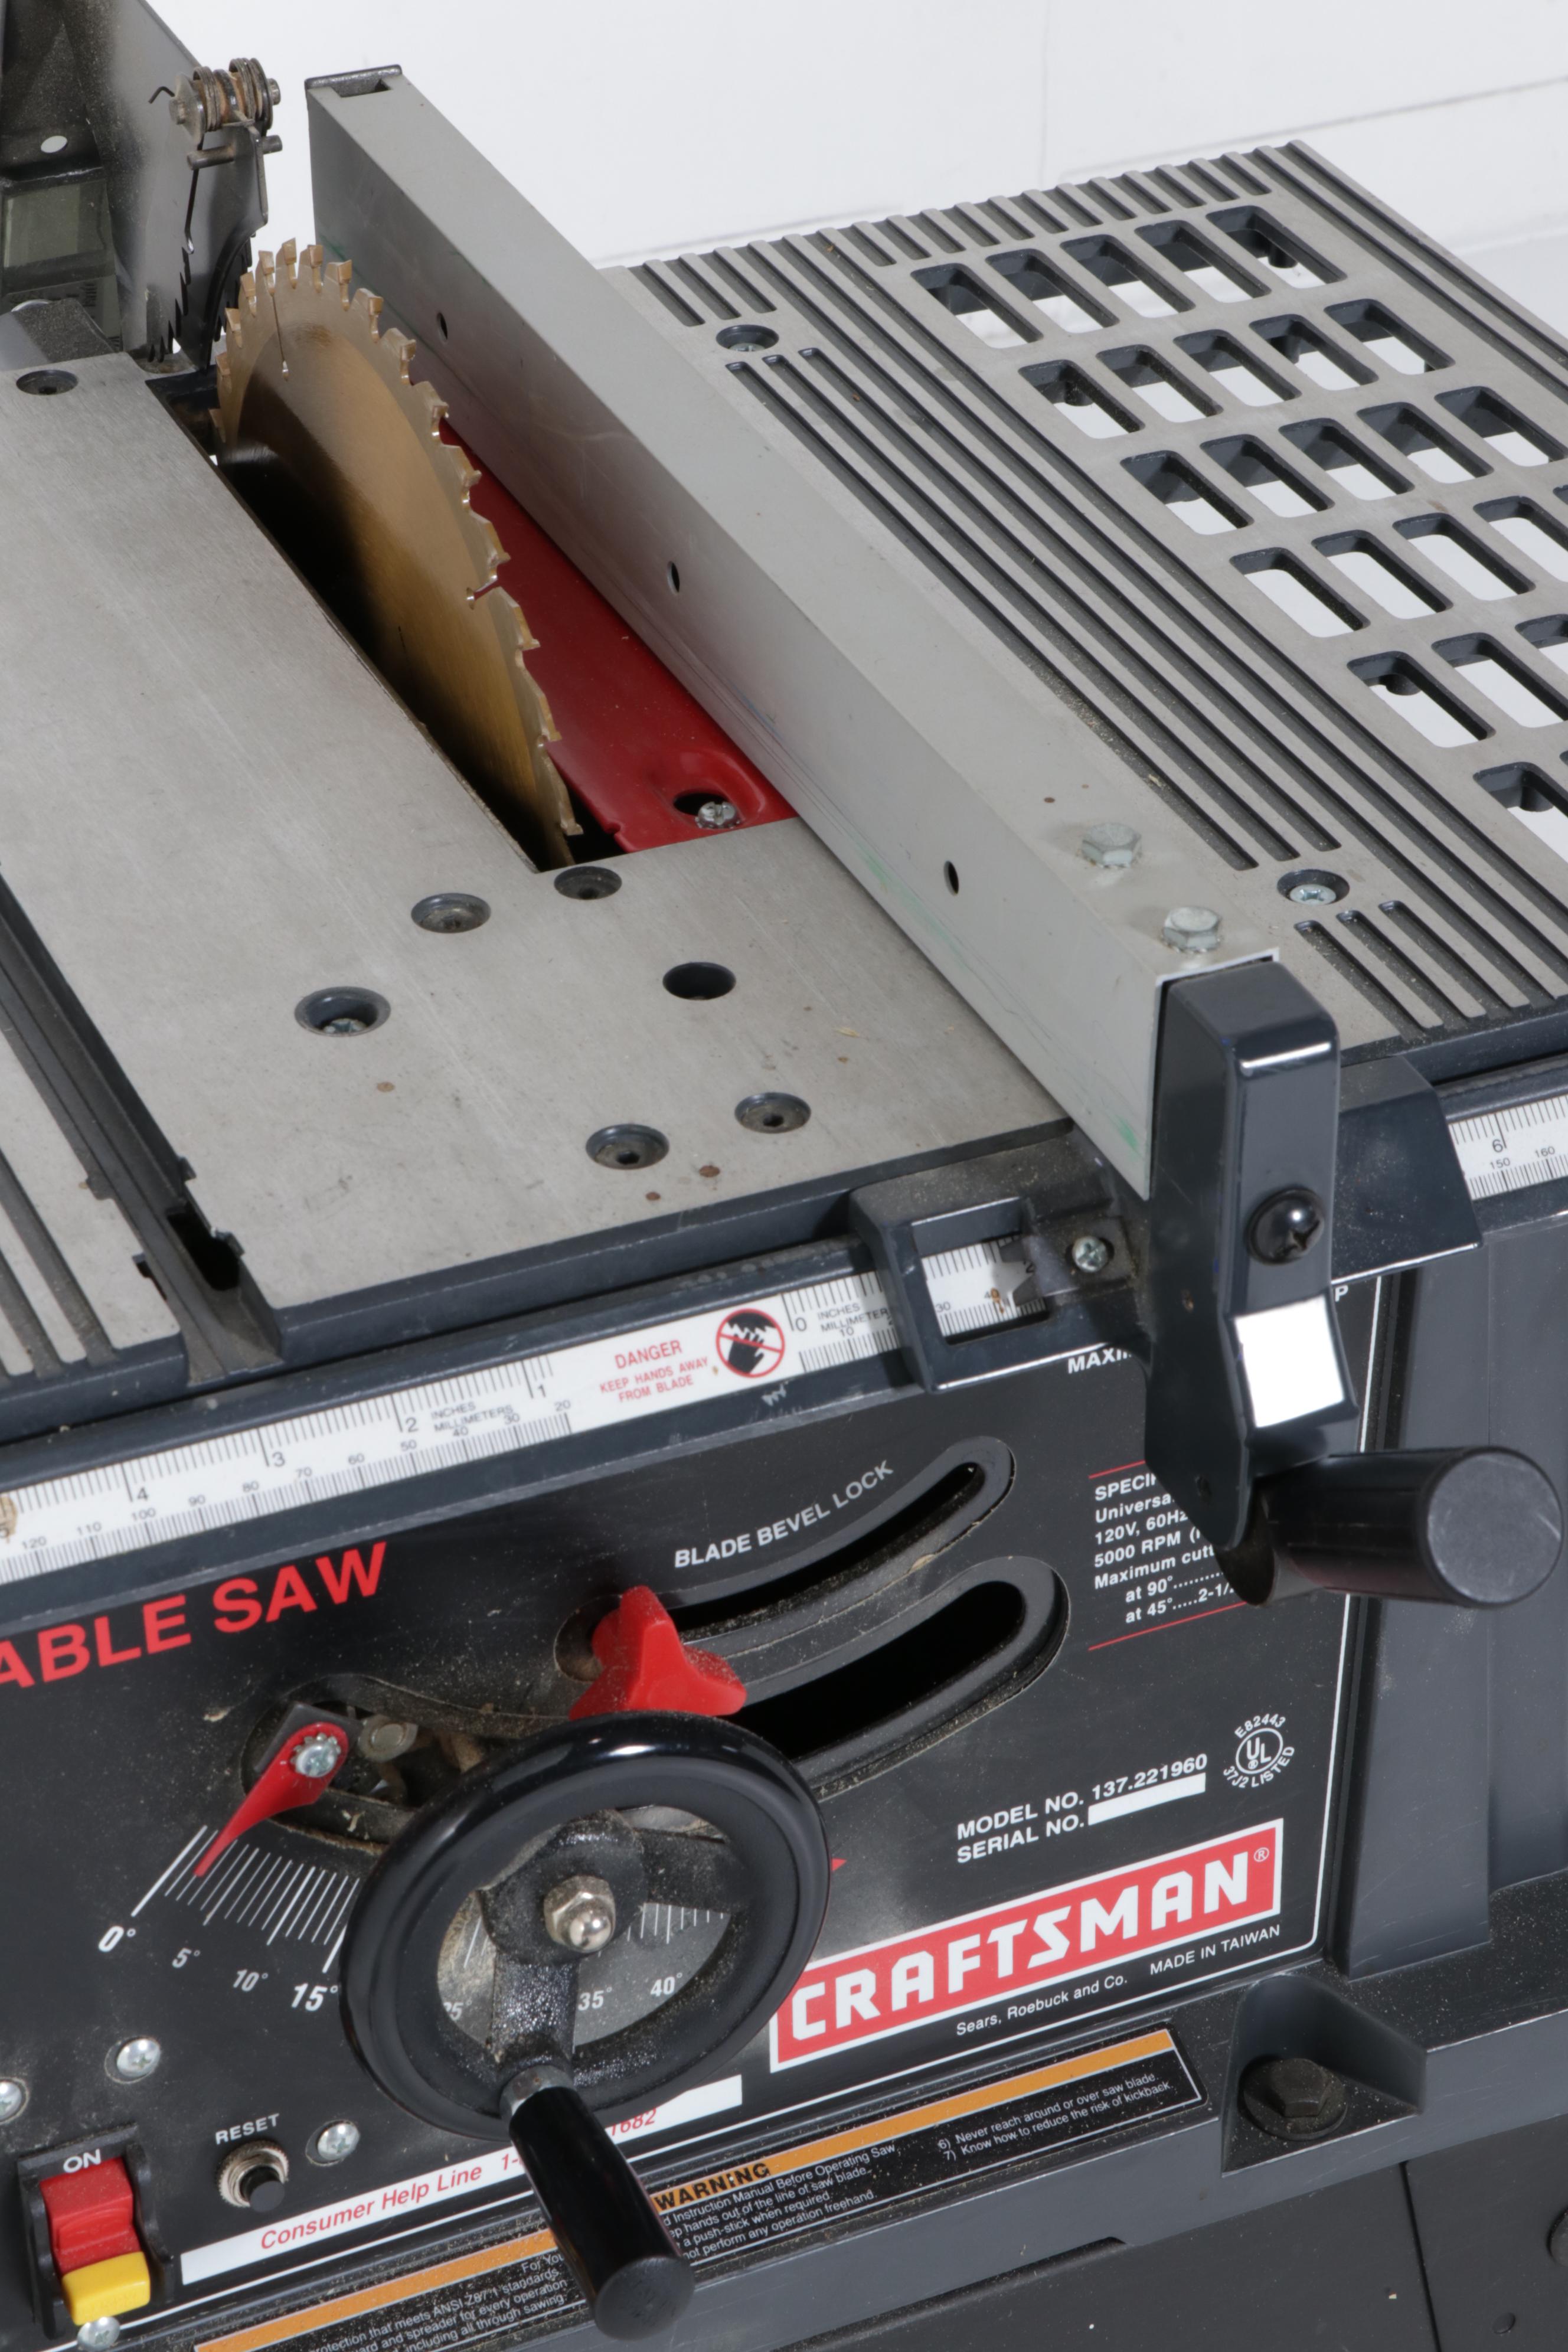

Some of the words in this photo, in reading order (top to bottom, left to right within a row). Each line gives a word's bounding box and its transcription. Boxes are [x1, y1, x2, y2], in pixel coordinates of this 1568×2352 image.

[1492, 1139, 1504, 1153] 6
[1536, 1146, 1556, 1158] 160
[1490, 1157, 1511, 1170] 150
[818, 1302, 861, 1320] INCHES
[820, 1307, 890, 1332] MILLIMETER
[936, 1302, 951, 1314] 30
[795, 1317, 808, 1332] 0
[839, 1327, 854, 1337] 10
[614, 1340, 682, 1369] DANGER
[1067, 1347, 1132, 1374] MAXI
[599, 1377, 629, 1394] KEEP
[634, 1366, 674, 1385] HANDS
[680, 1357, 710, 1373] AWAY
[538, 1383, 546, 1398] 1
[618, 1387, 652, 1403] FROM
[656, 1375, 694, 1394] BLADE
[430, 1401, 476, 1420] INCHES
[434, 1404, 515, 1433] MILLIMETERS
[554, 1399, 572, 1412] 20
[405, 1417, 419, 1433] 2
[452, 1426, 469, 1437] 40
[504, 1413, 521, 1425] 30
[400, 1439, 418, 1452] 50
[272, 1451, 286, 1468] 3
[295, 1466, 313, 1478] 70
[348, 1453, 365, 1465] 60
[136, 1487, 149, 1501] 4
[241, 1480, 260, 1493] 80
[188, 1494, 206, 1506] 90
[1095, 1492, 1175, 1524] Universa
[130, 1507, 156, 1521] 100
[674, 1533, 753, 1569] BLADE
[756, 1502, 831, 1547] BEVEL
[832, 1459, 894, 1509] LOCK
[76, 1521, 103, 1535] 110
[1095, 1521, 1141, 1546] 120V,
[21, 1535, 47, 1550] 120
[1094, 1544, 1136, 1568] 5000
[1141, 1530, 1181, 1554] RPM
[1094, 1556, 1177, 1590] Maximum
[211, 1541, 387, 1634] SAW
[1125, 1586, 1142, 1603] at
[1125, 1607, 1142, 1623] at
[1234, 1713, 1286, 1739] E82443
[1246, 1736, 1272, 1764] UL
[1251, 1746, 1295, 1788] LISTED
[957, 1803, 1038, 1840] MODEL
[1045, 1791, 1084, 1816] NO.
[1092, 1753, 1208, 1801] 137.221960
[956, 1830, 1039, 1864] SERIAL
[1045, 1814, 1085, 1839] NO.
[1149, 1949, 1195, 1975] MADE
[1200, 1944, 1216, 1960] IN
[1220, 1924, 1281, 1954] TAIWAN
[956, 2013, 1002, 2037] Sears,
[1007, 1991, 1069, 2020] Roebuck
[1073, 1980, 1099, 1999] and
[1103, 1974, 1128, 1990] Co.
[214, 2112, 280, 2145] RESET
[937, 2138, 951, 2150] 6)
[955, 2126, 989, 2144] Never
[990, 2116, 1022, 2132] reach
[1023, 2102, 1061, 2122] around
[1063, 2098, 1074, 2110] or
[1076, 2091, 1100, 2105] over
[1102, 2084, 1124, 2098] saw
[943, 2149, 957, 2162] 7)
[960, 2138, 992, 2156] Know
[993, 2131, 1018, 2145] how
[1018, 2127, 1030, 2138] to
[1033, 2114, 1069, 2133] reduce
[1070, 2107, 1089, 2121] the
[1090, 2100, 1111, 2113] risk
[1112, 2095, 1123, 2107] of
[63, 2148, 102, 2174] ON
[654, 2162, 770, 2211] WARNING
[673, 2197, 731, 2223] Instruction
[732, 2181, 775, 2203] Manual
[775, 2170, 814, 2190] Before
[815, 2152, 870, 2178] Operating
[260, 2197, 375, 2250] Consumer
[381, 2183, 429, 2210] Help
[436, 2164, 482, 2193] Line
[683, 2214, 720, 2233] hands
[721, 2208, 741, 2221] out
[742, 2203, 753, 2215] of
[754, 2197, 773, 2211] the
[775, 2190, 796, 2203] line
[798, 2184, 809, 2196] of
[811, 2179, 834, 2192] saw
[683, 2238, 691, 2247] a
[692, 2218, 750, 2246] push-stick
[751, 2207, 782, 2224] when
[702, 2233, 747, 2257] perform
[748, 2226, 768, 2239] any
[771, 2208, 823, 2232] operation
[824, 2189, 878, 2213] freehand.
[521, 2259, 541, 2273] For
[309, 2332, 367, 2352] rotection
[369, 2324, 393, 2340] that
[394, 2310, 431, 2328] meets
[433, 2298, 464, 2318] ANSI
[381, 2333, 404, 2349] and
[407, 2317, 457, 2340] spreader
[459, 2309, 476, 2322] for
[479, 2298, 511, 2315] every
[513, 2278, 568, 2305] operation
[461, 2321, 475, 2336] all
[476, 2306, 521, 2331] through
[523, 2293, 565, 2315] sawing
